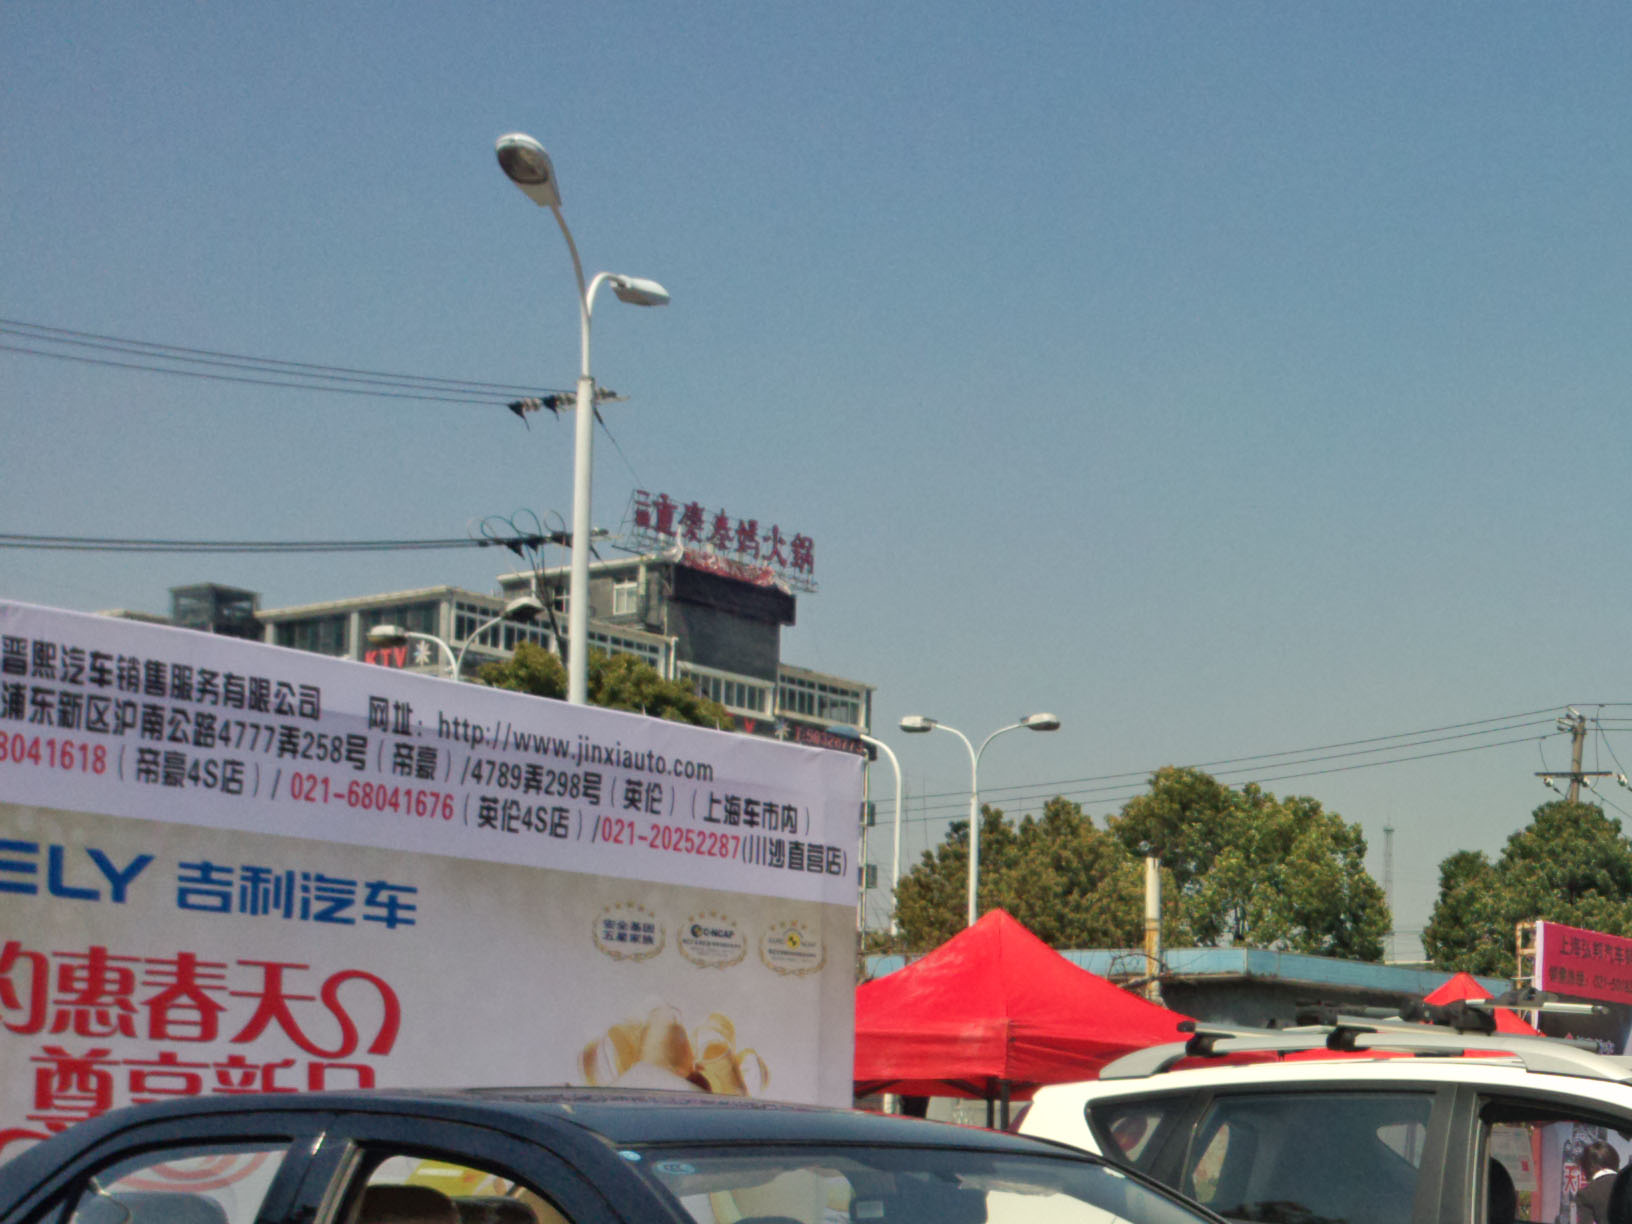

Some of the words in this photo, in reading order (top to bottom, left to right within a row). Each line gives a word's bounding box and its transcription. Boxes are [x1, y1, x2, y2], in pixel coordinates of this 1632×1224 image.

[365, 646, 408, 668] KTV
[177, 861, 419, 929] 吉利汽车
